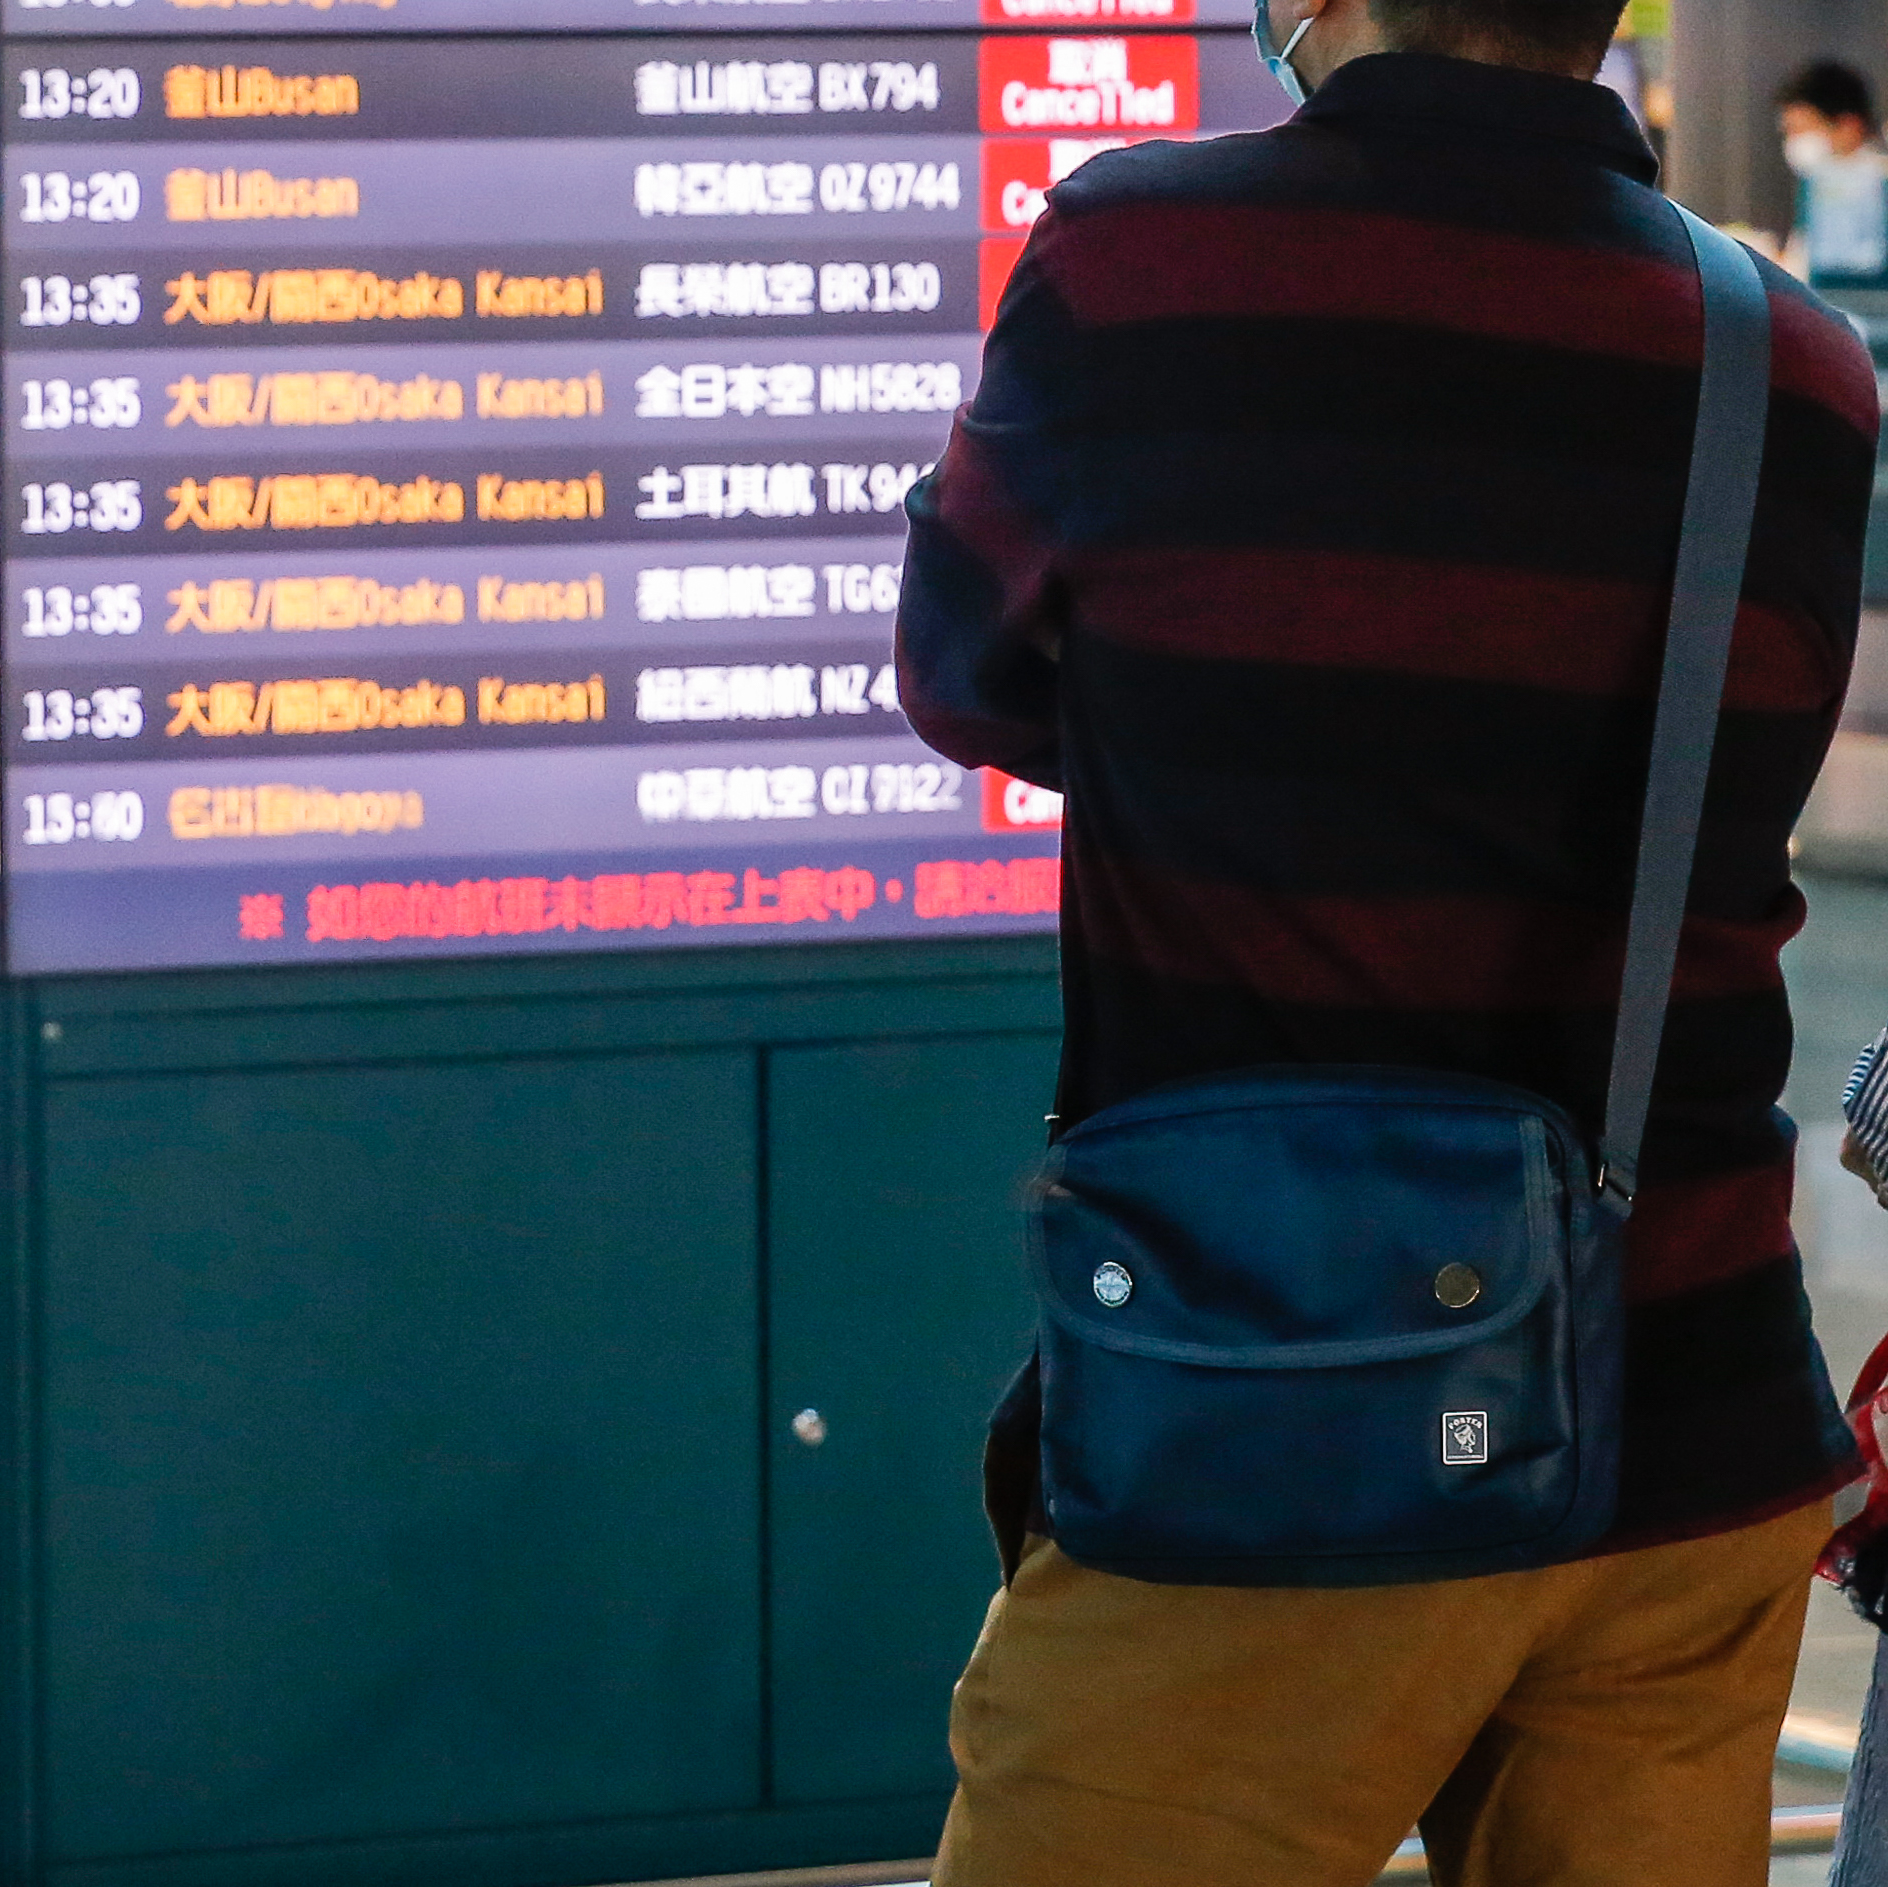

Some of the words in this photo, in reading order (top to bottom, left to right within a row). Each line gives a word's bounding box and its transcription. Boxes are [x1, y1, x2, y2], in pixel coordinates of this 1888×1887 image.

[20, 68, 139, 118] 13:20
[820, 63, 939, 110] BX794
[1002, 78, 1174, 125] Cancelled
[22, 172, 139, 221] 13:20
[821, 163, 959, 211] OZ9744
[22, 274, 139, 325] 13:35
[475, 271, 604, 317] Kansai
[820, 263, 940, 312] BR130
[23, 378, 140, 429] 13:35
[23, 481, 141, 533] 13:35
[24, 584, 141, 635] 13:35
[24, 687, 142, 740] 13:35
[1448, 1416, 1483, 1430] PORTER
